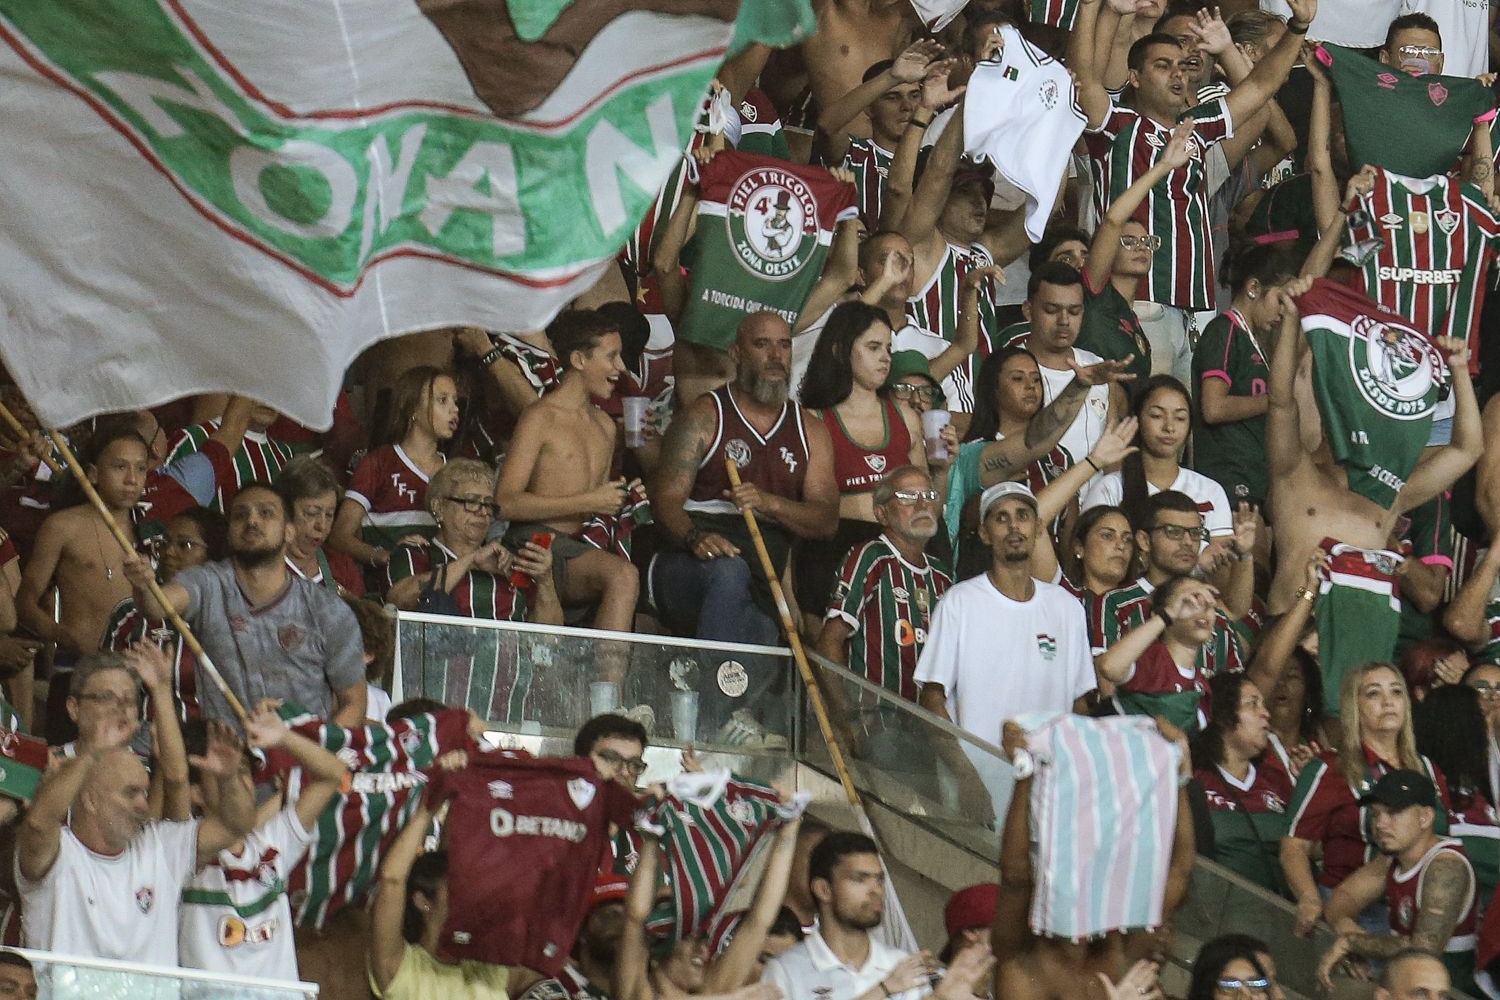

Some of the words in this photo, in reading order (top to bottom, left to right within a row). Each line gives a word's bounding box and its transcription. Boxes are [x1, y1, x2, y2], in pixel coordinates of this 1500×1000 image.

[733, 177, 759, 207] FIEL
[760, 170, 817, 228] TRICOLOR
[737, 240, 762, 270] ZONA
[765, 254, 801, 276] OESTE
[1379, 266, 1463, 286] SUPERBET
[711, 290, 746, 311] TORCIDA
[1359, 366, 1394, 411] DESDE
[1395, 398, 1427, 414] 1975
[391, 472, 417, 504] TFT
[846, 476, 867, 487] FIEL
